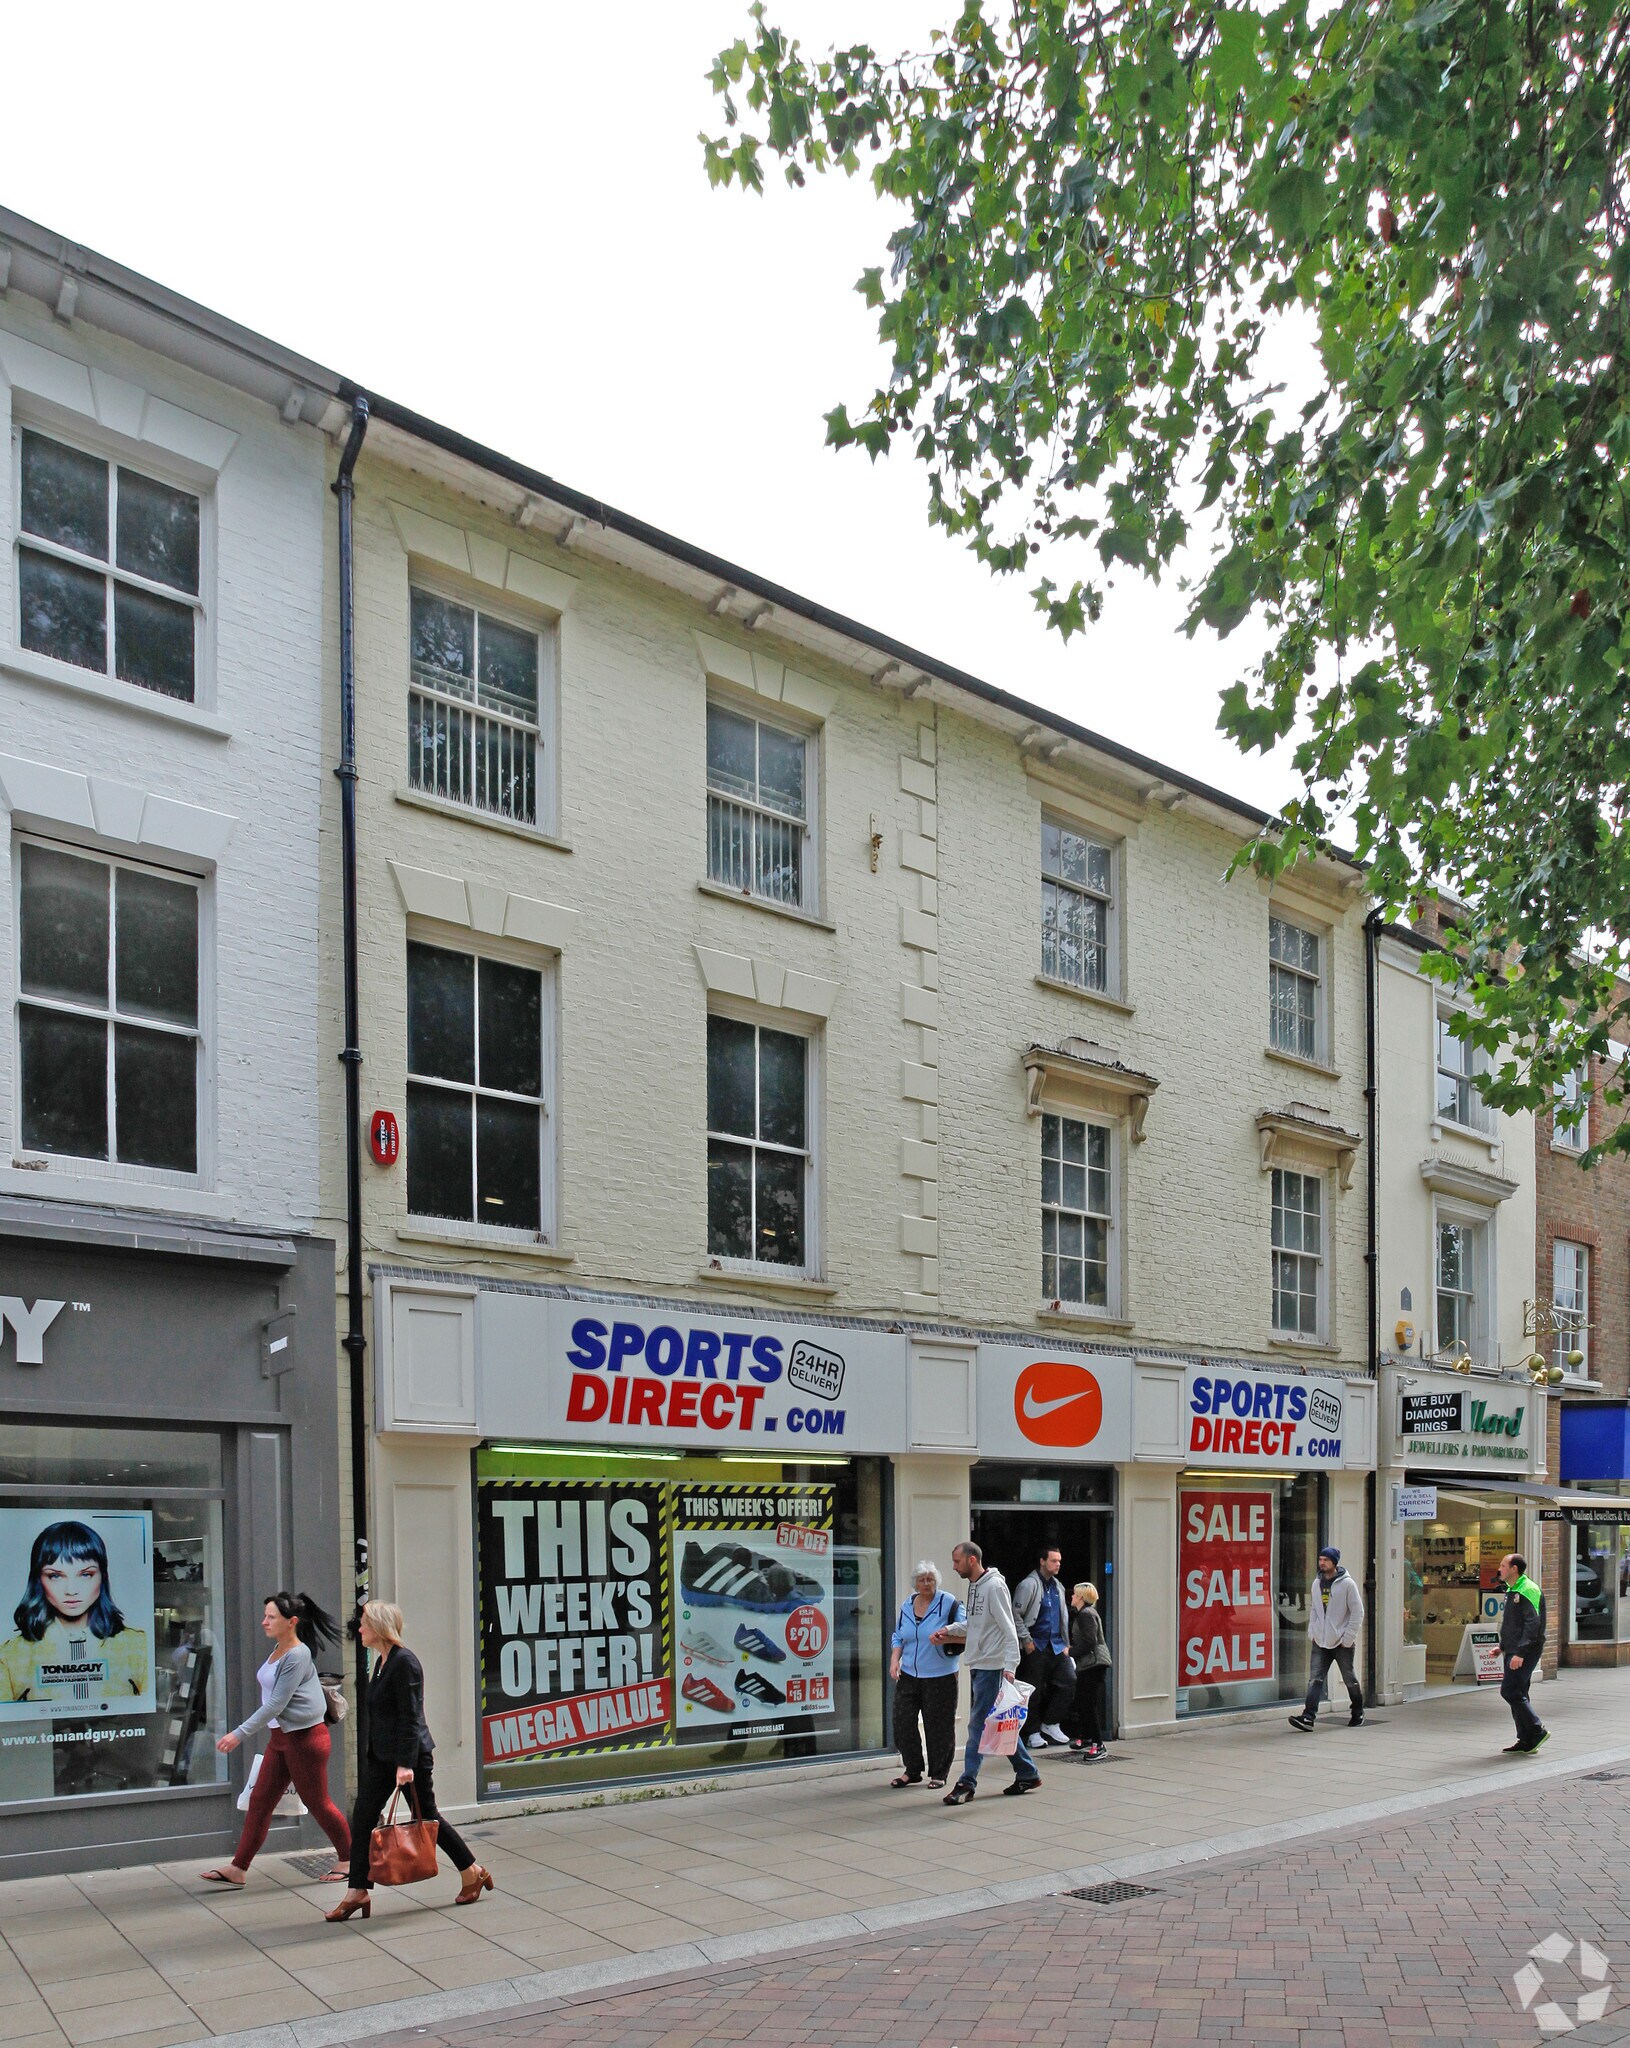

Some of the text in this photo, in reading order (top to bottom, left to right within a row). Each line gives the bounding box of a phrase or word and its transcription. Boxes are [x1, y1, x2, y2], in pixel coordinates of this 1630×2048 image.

[0, 1296, 67, 1364] Y
[566, 1317, 785, 1384] SPORTS
[794, 1349, 840, 1380] 24HR
[791, 1366, 839, 1393] DELIVERY
[566, 1372, 766, 1431] DIRECT
[1189, 1376, 1308, 1421] SPORTS
[1313, 1396, 1339, 1416] 24HR
[1410, 1395, 1452, 1407] WE BUY
[1311, 1408, 1338, 1428] DELIVERY
[1405, 1407, 1457, 1420] DIAMOND
[1413, 1421, 1448, 1432] RINGS
[1471, 1399, 1525, 1437] llard
[1189, 1416, 1297, 1456] DIRECT
[1408, 1440, 1529, 1460] JEWELLERS & PAWNBROKERS
[683, 1497, 823, 1517] THIS WEEK'S OFFER!
[1571, 1509, 1593, 1521] Mallard
[1594, 1509, 1617, 1521] Jewellers
[1618, 1510, 1623, 1521] &
[1186, 1503, 1265, 1543] SALE
[491, 1498, 651, 1579] THIS
[1185, 1568, 1265, 1610] SALE
[495, 1579, 653, 1636] WEEK'S
[789, 1625, 822, 1652] £20
[1474, 1634, 1496, 1643] Mallard
[500, 1633, 654, 1698] OFFER!
[1185, 1633, 1266, 1676] SALE
[41, 1662, 104, 1675] TONI&GUY
[65, 1676, 87, 1684] FASHION
[789, 1689, 803, 1701] £15
[489, 1684, 664, 1757] MEGA VALUE
[732, 1723, 785, 1736] WHILST STOCKS LAST
[2, 1727, 146, 1746] www.toniandguy.com
